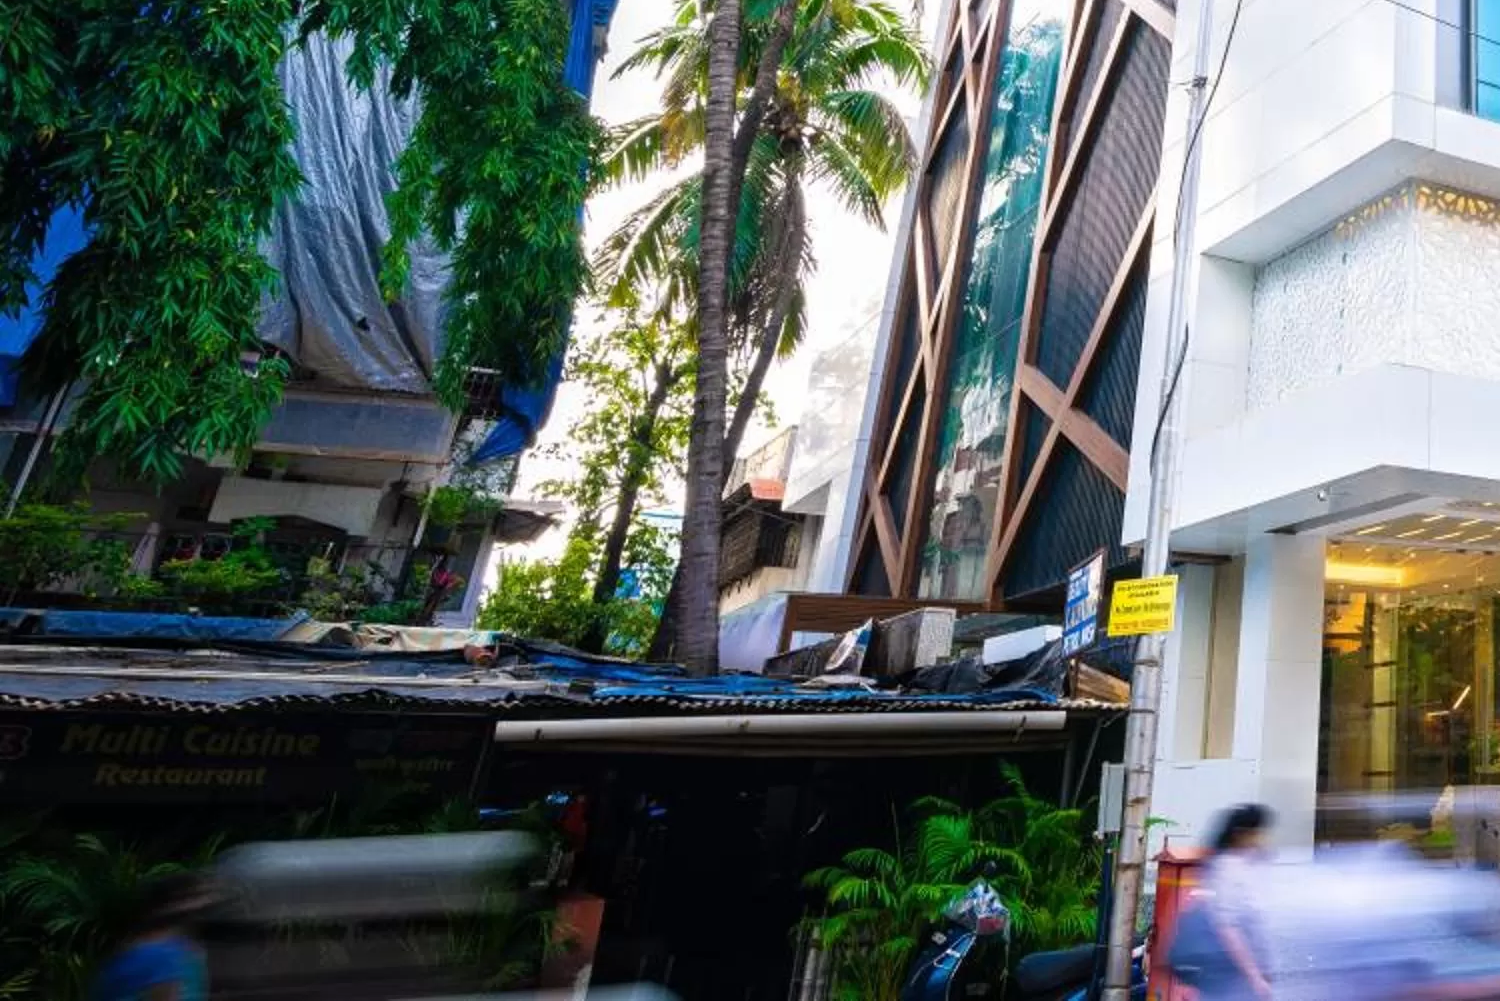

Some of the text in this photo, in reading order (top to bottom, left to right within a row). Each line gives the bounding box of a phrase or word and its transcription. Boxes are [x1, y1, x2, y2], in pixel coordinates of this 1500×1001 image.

[57, 723, 171, 756] Multi
[182, 723, 321, 757] Cuisine
[91, 763, 267, 787] Restaurant
